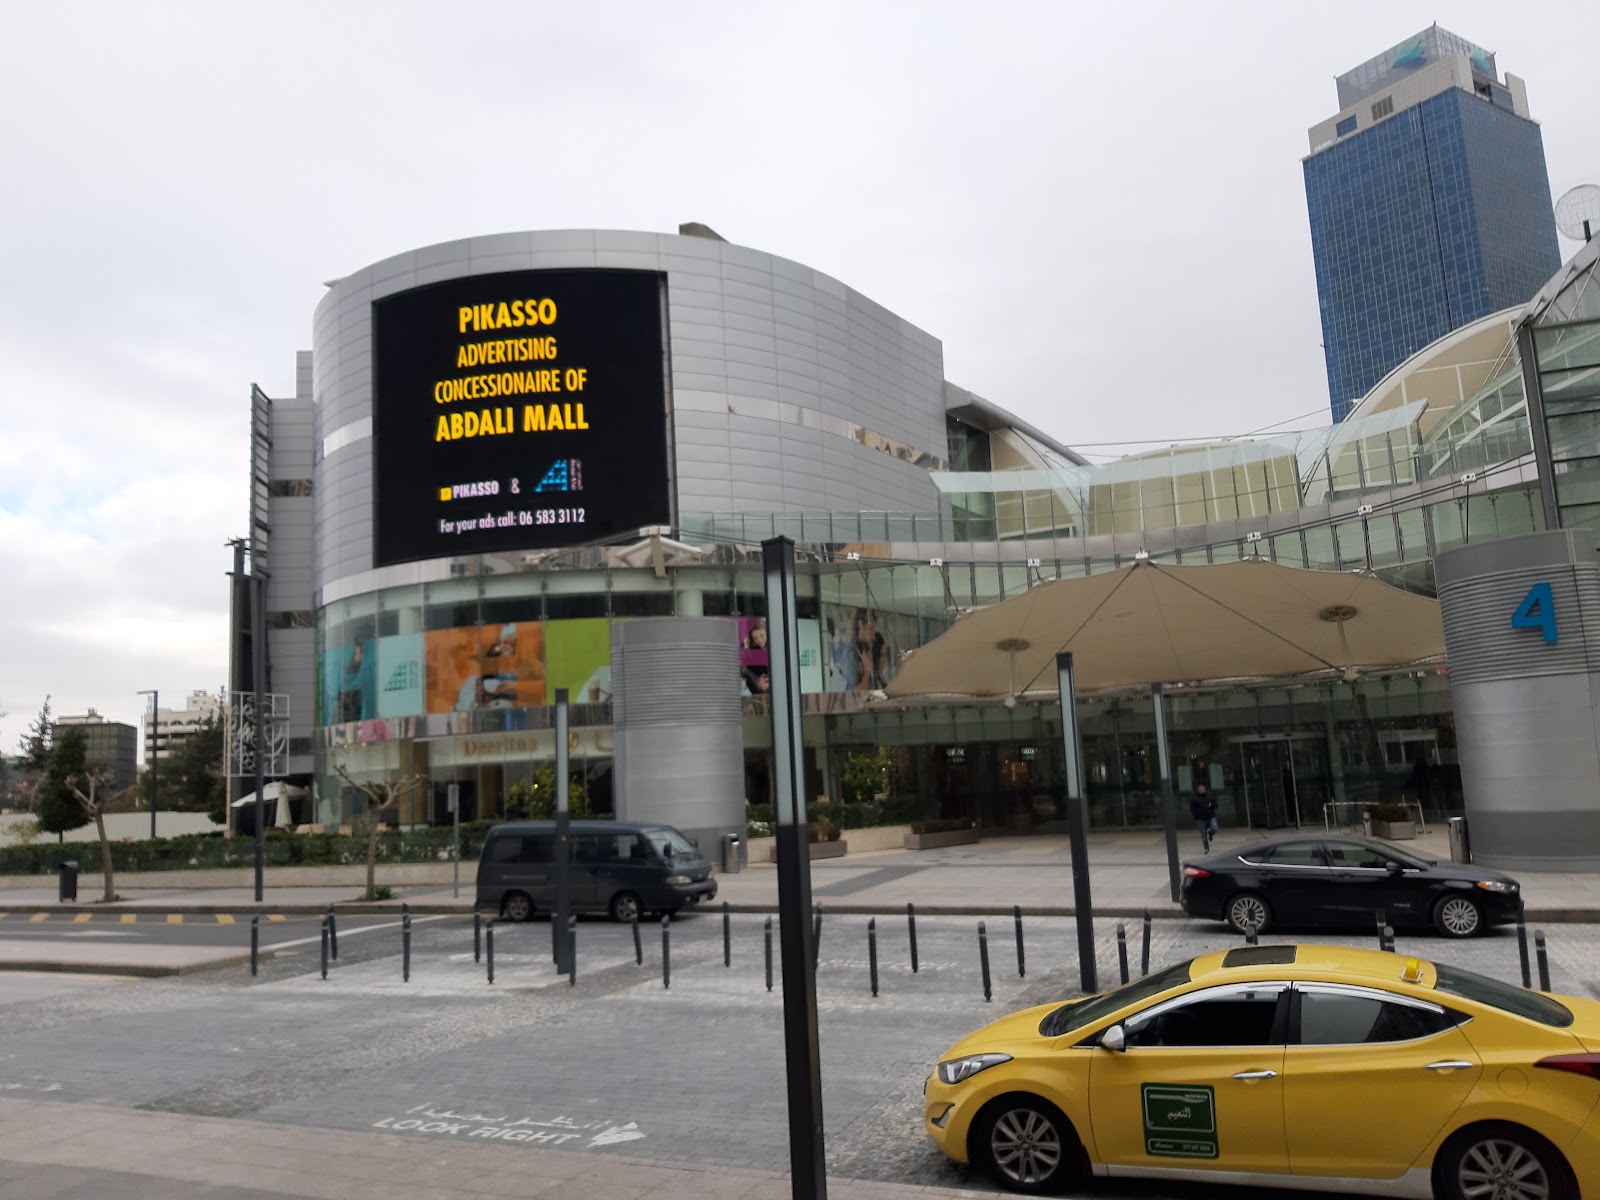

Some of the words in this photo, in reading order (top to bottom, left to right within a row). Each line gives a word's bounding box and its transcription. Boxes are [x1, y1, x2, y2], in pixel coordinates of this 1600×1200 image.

[459, 298, 557, 333] PIKASSO
[457, 336, 557, 368] ADVERTISING
[434, 370, 560, 404] CONCESSIONAIRE
[565, 368, 587, 391] OF
[435, 406, 514, 442] ABDALI
[524, 403, 589, 432] MALL
[453, 480, 499, 499] PIKASSO
[511, 478, 520, 494] &
[440, 519, 455, 533] For
[456, 520, 477, 534] your
[479, 513, 495, 528] ads
[498, 511, 517, 527] call:
[519, 511, 533, 525] 06
[536, 509, 556, 524] 583
[558, 508, 585, 523] 3112
[1511, 582, 1559, 645] 4
[371, 1117, 470, 1135] LOOK
[468, 1126, 582, 1145] RIGHT
